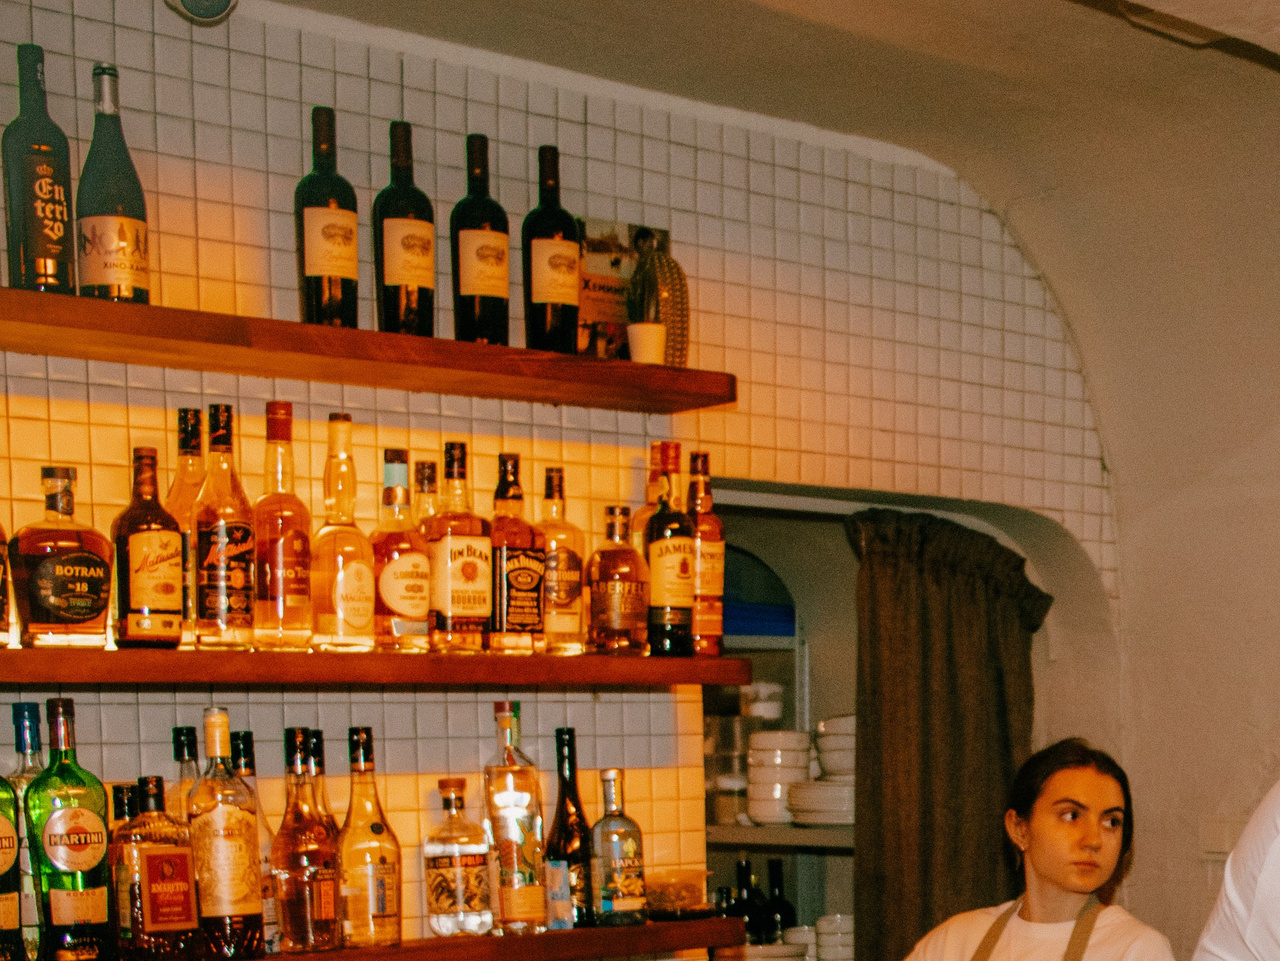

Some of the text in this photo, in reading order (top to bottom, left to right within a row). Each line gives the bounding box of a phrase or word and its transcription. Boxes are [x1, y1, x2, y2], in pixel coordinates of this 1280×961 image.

[34, 177, 65, 201] En
[55, 564, 104, 578] BOTRAN
[75, 581, 88, 593] 18
[50, 832, 103, 846] MARTINI
